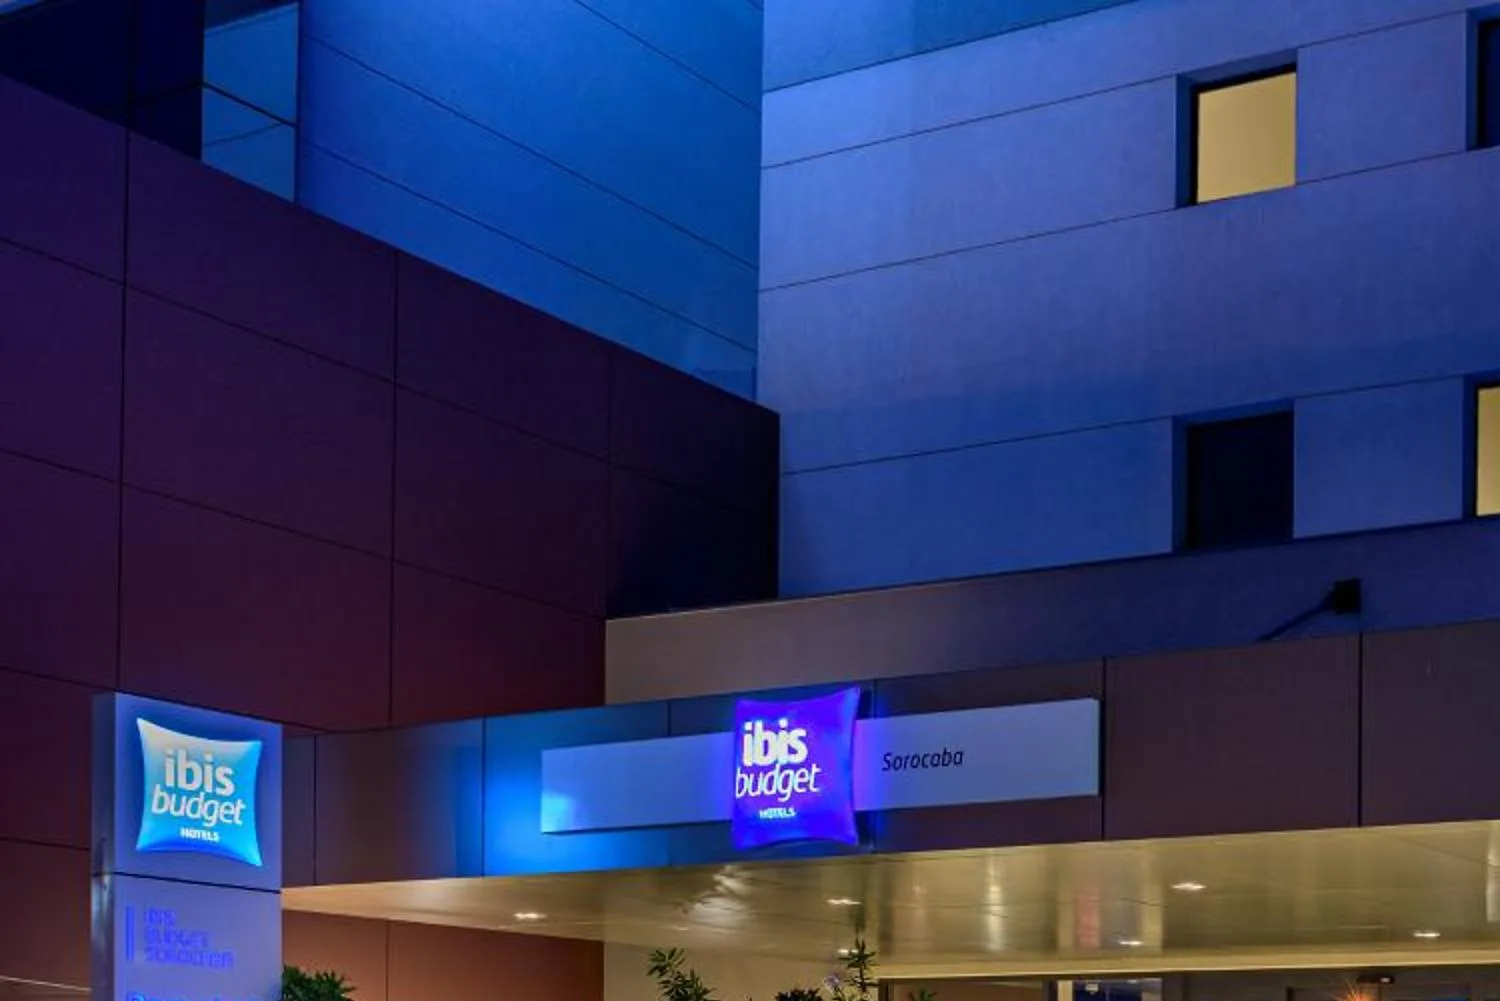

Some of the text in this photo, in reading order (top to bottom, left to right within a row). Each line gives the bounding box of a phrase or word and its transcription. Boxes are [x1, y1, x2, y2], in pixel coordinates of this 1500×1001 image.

[743, 718, 809, 766] ibis
[882, 747, 965, 772] Sorocaba
[165, 748, 235, 797] ibis
[735, 763, 821, 802] budget
[152, 783, 246, 827] budget
[758, 806, 797, 819] HOTELS
[180, 827, 220, 842] HOTELS
